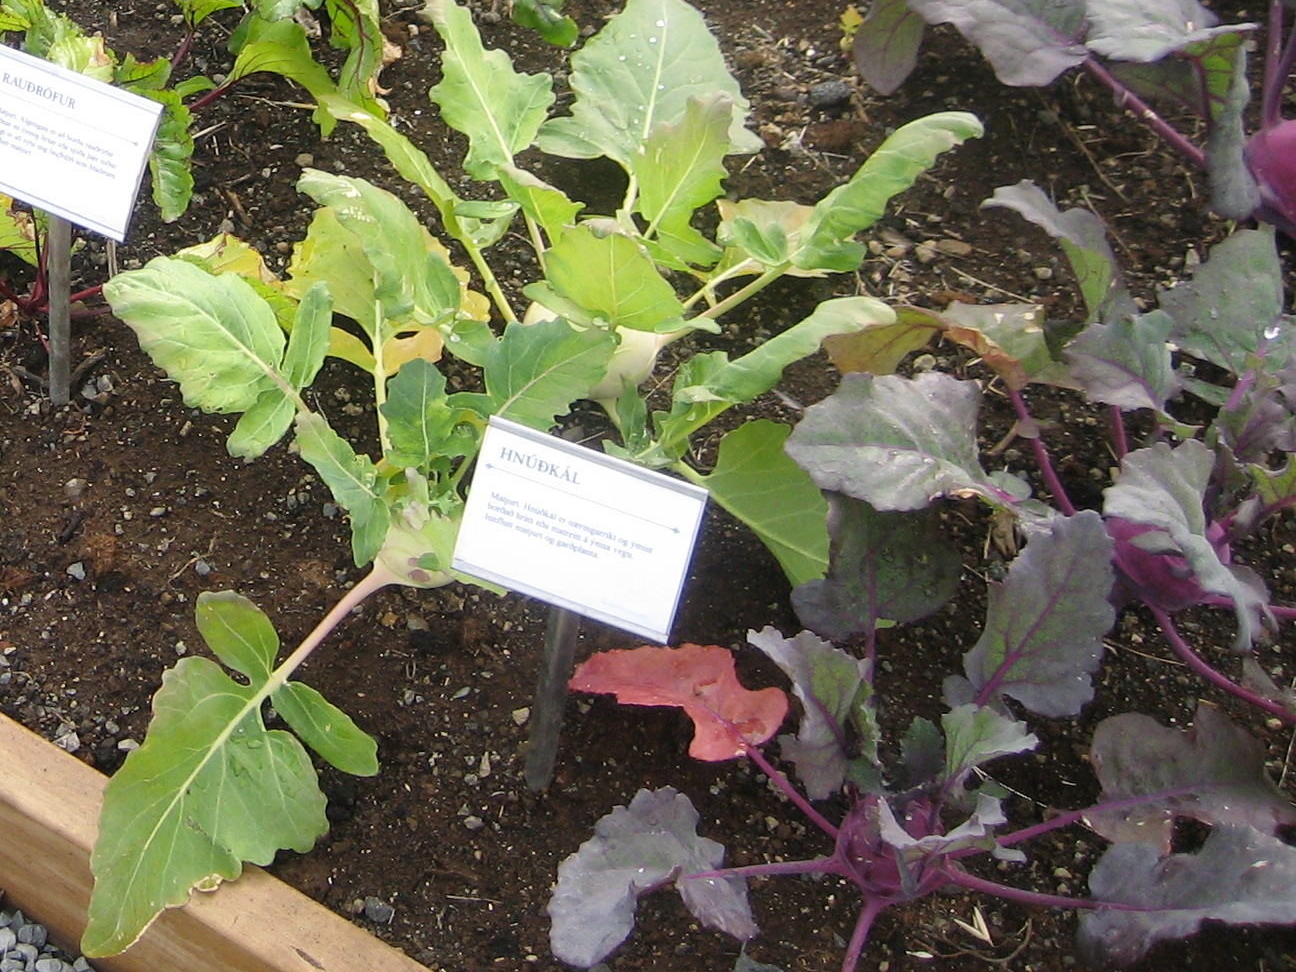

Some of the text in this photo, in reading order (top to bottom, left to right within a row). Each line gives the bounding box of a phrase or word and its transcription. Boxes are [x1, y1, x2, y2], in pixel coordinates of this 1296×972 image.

[2, 72, 76, 109] RAUÐRÓFUR
[499, 447, 580, 483] HNÚÐKÁL
[523, 502, 557, 520] Hnúðkál
